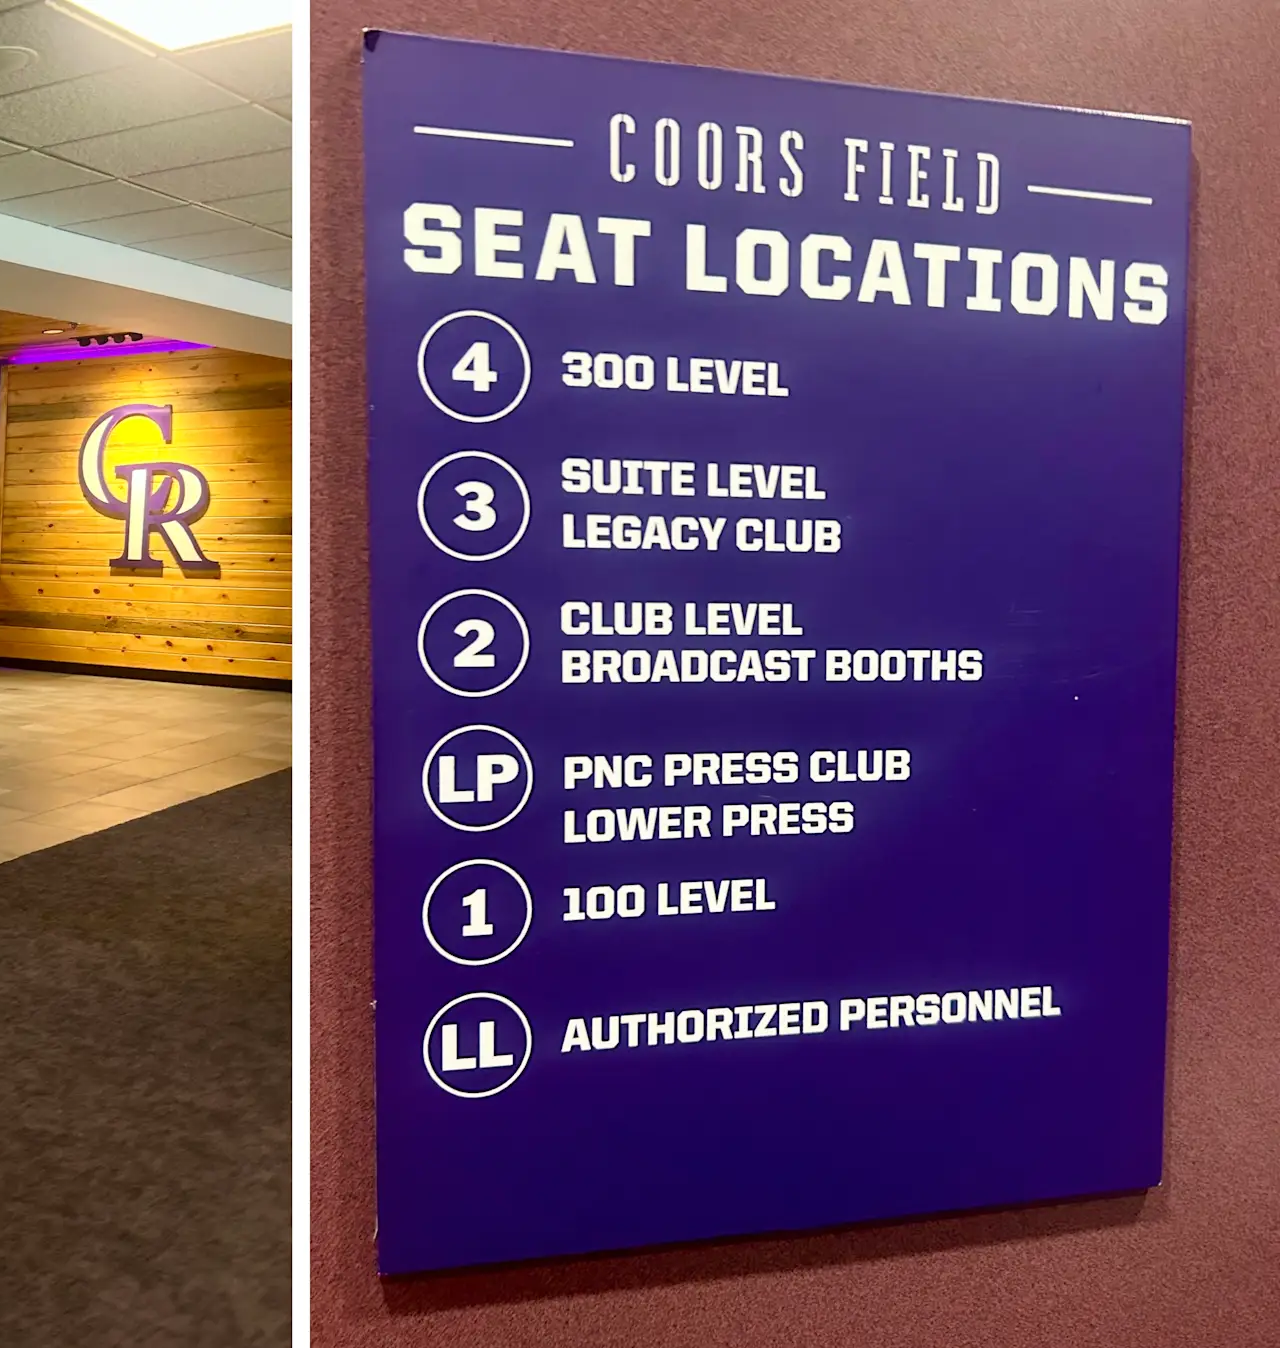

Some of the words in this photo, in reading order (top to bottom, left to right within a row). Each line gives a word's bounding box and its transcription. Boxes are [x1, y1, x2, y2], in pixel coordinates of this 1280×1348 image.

[608, 113, 805, 197] COORS
[843, 137, 1001, 216] FIELD
[403, 202, 651, 287] SEAT
[686, 223, 1169, 325] LOCATIONS
[452, 342, 498, 392] 4
[562, 351, 655, 390] 300
[666, 356, 789, 397] LEVEL
[561, 458, 695, 496] SUITE
[707, 463, 826, 500] LEVEL
[453, 481, 496, 531] 3
[562, 513, 727, 551] LEGACY
[736, 518, 841, 553] CLUB
[560, 601, 673, 635] CLUB
[685, 602, 803, 636] LEVEL
[453, 619, 495, 668] 2
[561, 649, 816, 683] BROADCAST
[825, 649, 983, 681] BOOTHS
[439, 754, 519, 803] LP
[564, 754, 652, 790] PNC
[664, 751, 799, 786] PRESS
[809, 749, 911, 783] CLUB
[564, 805, 711, 844] LOWER
[722, 801, 854, 837] PRESS
[461, 888, 494, 937] 1
[563, 884, 645, 921] 100
[657, 878, 776, 916] LEVEL
[560, 1000, 829, 1053] AUTHORIZED
[840, 986, 1061, 1031] PERSONNEL
[441, 1021, 514, 1072] LL
